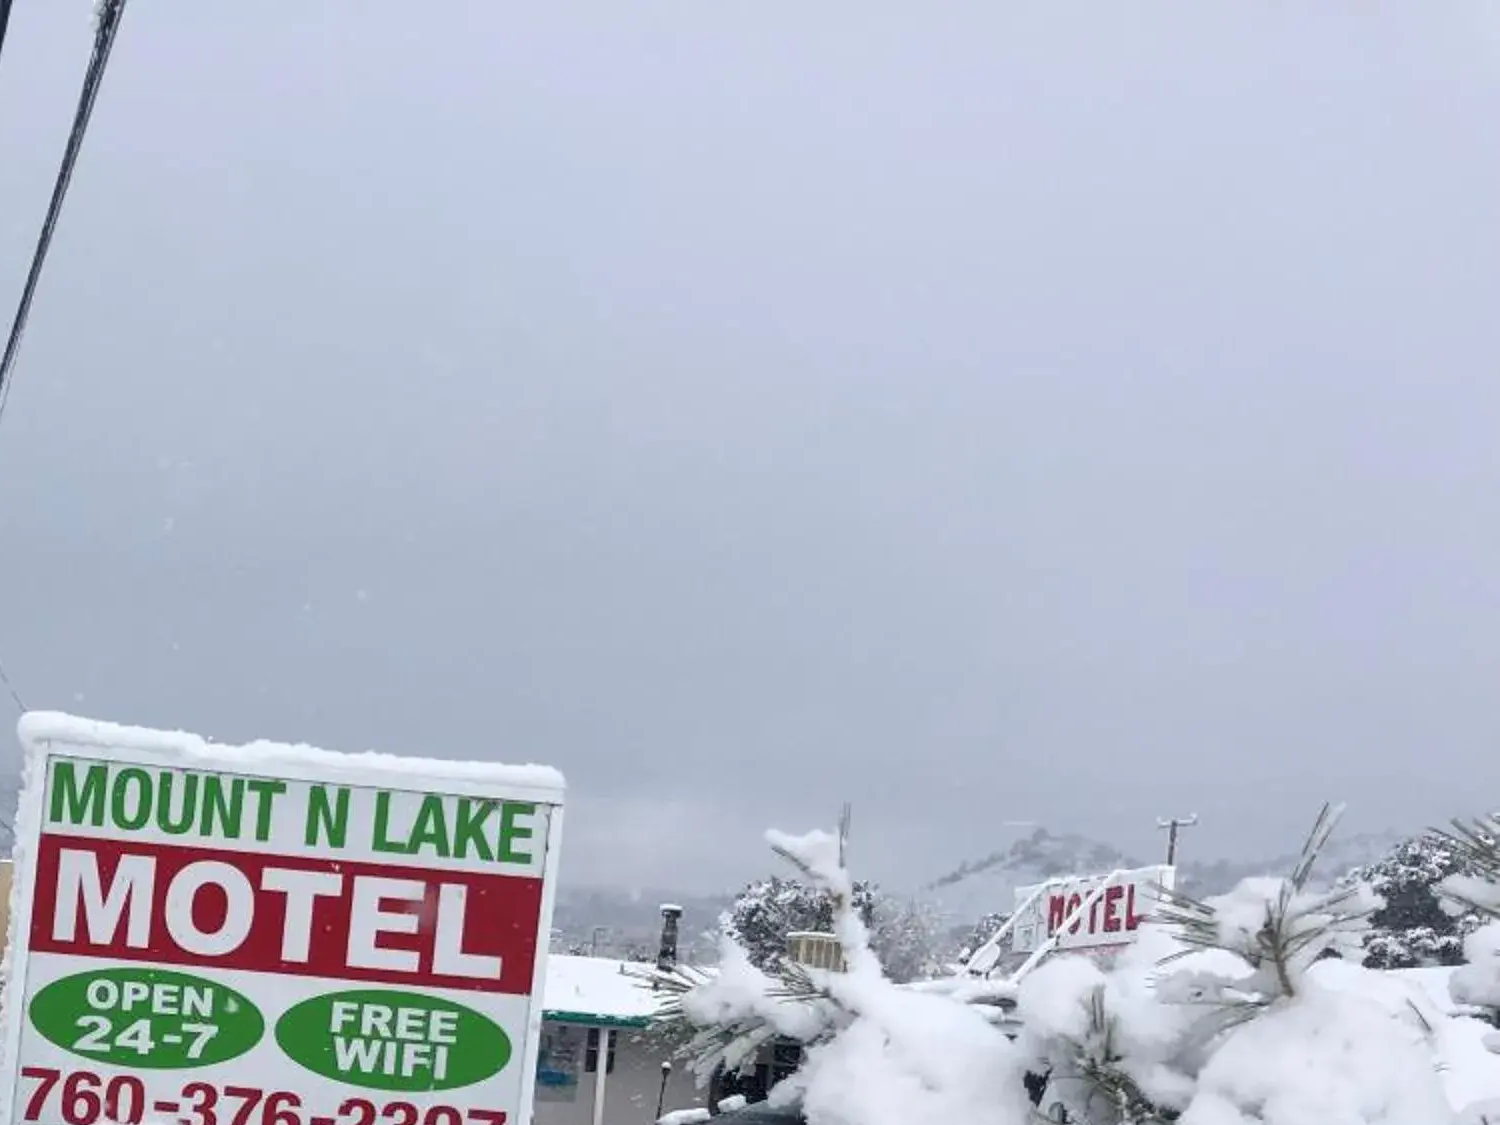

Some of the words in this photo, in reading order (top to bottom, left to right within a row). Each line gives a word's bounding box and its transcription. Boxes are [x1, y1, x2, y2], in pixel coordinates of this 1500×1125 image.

[49, 762, 287, 842] MOUNT
[305, 785, 350, 849] N
[372, 791, 535, 864] LAKE
[51, 848, 502, 980] MOTEL
[87, 979, 213, 1018] OPEN
[73, 1015, 219, 1059] 24-7
[329, 1001, 460, 1043] FREE
[335, 1038, 448, 1080] WIFI
